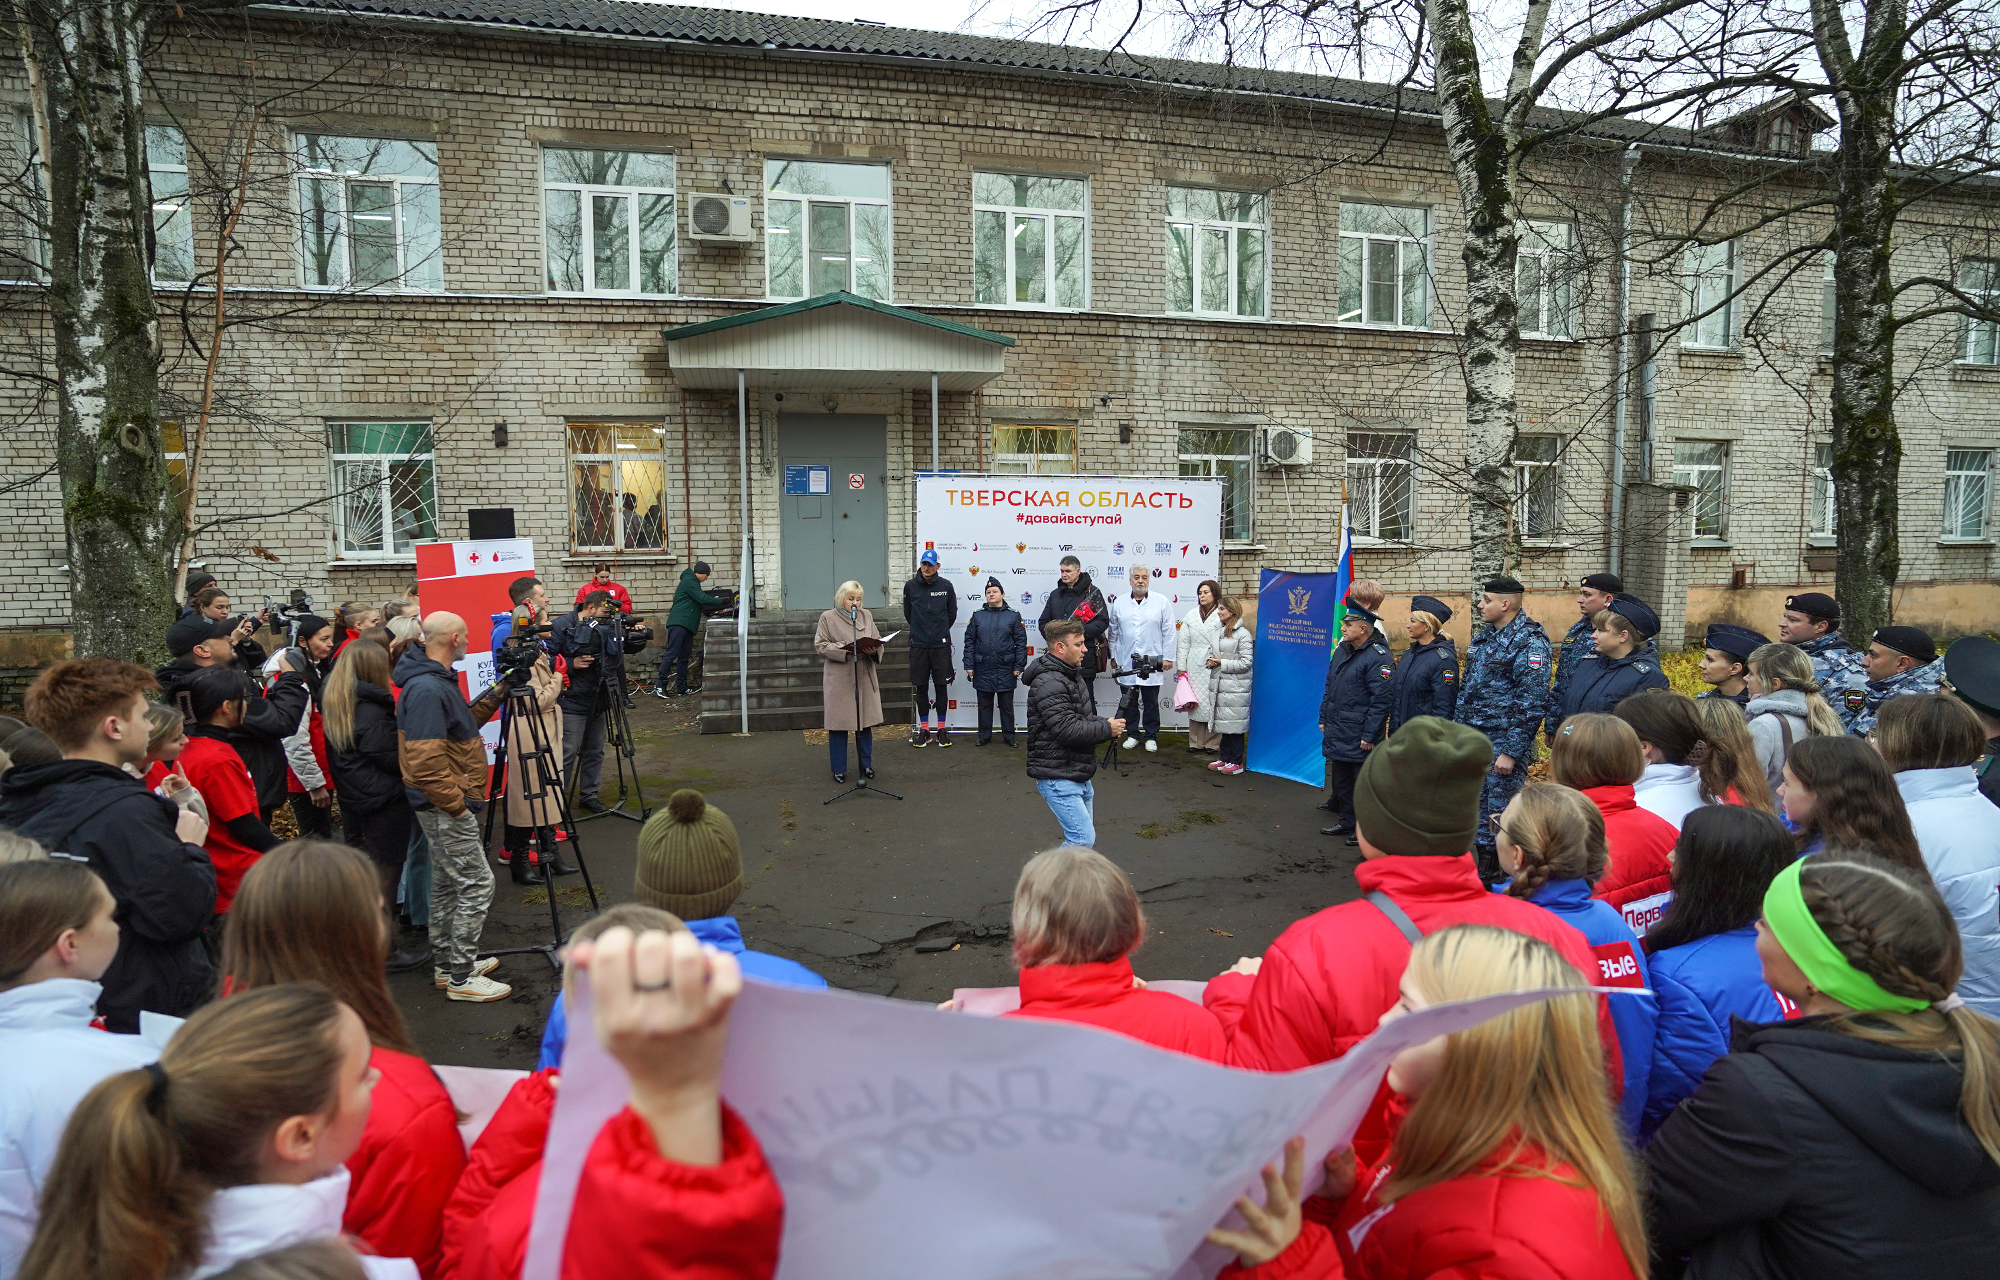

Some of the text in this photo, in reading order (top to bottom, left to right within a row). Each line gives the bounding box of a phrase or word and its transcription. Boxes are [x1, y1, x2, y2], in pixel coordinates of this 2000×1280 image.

[945, 490, 1193, 509] ТВЕРСКАЯ ОБЛАСТЬ
[1016, 512, 1122, 526] #давайвступай
[479, 670, 486, 678] С
[1625, 906, 1662, 930] Перв
